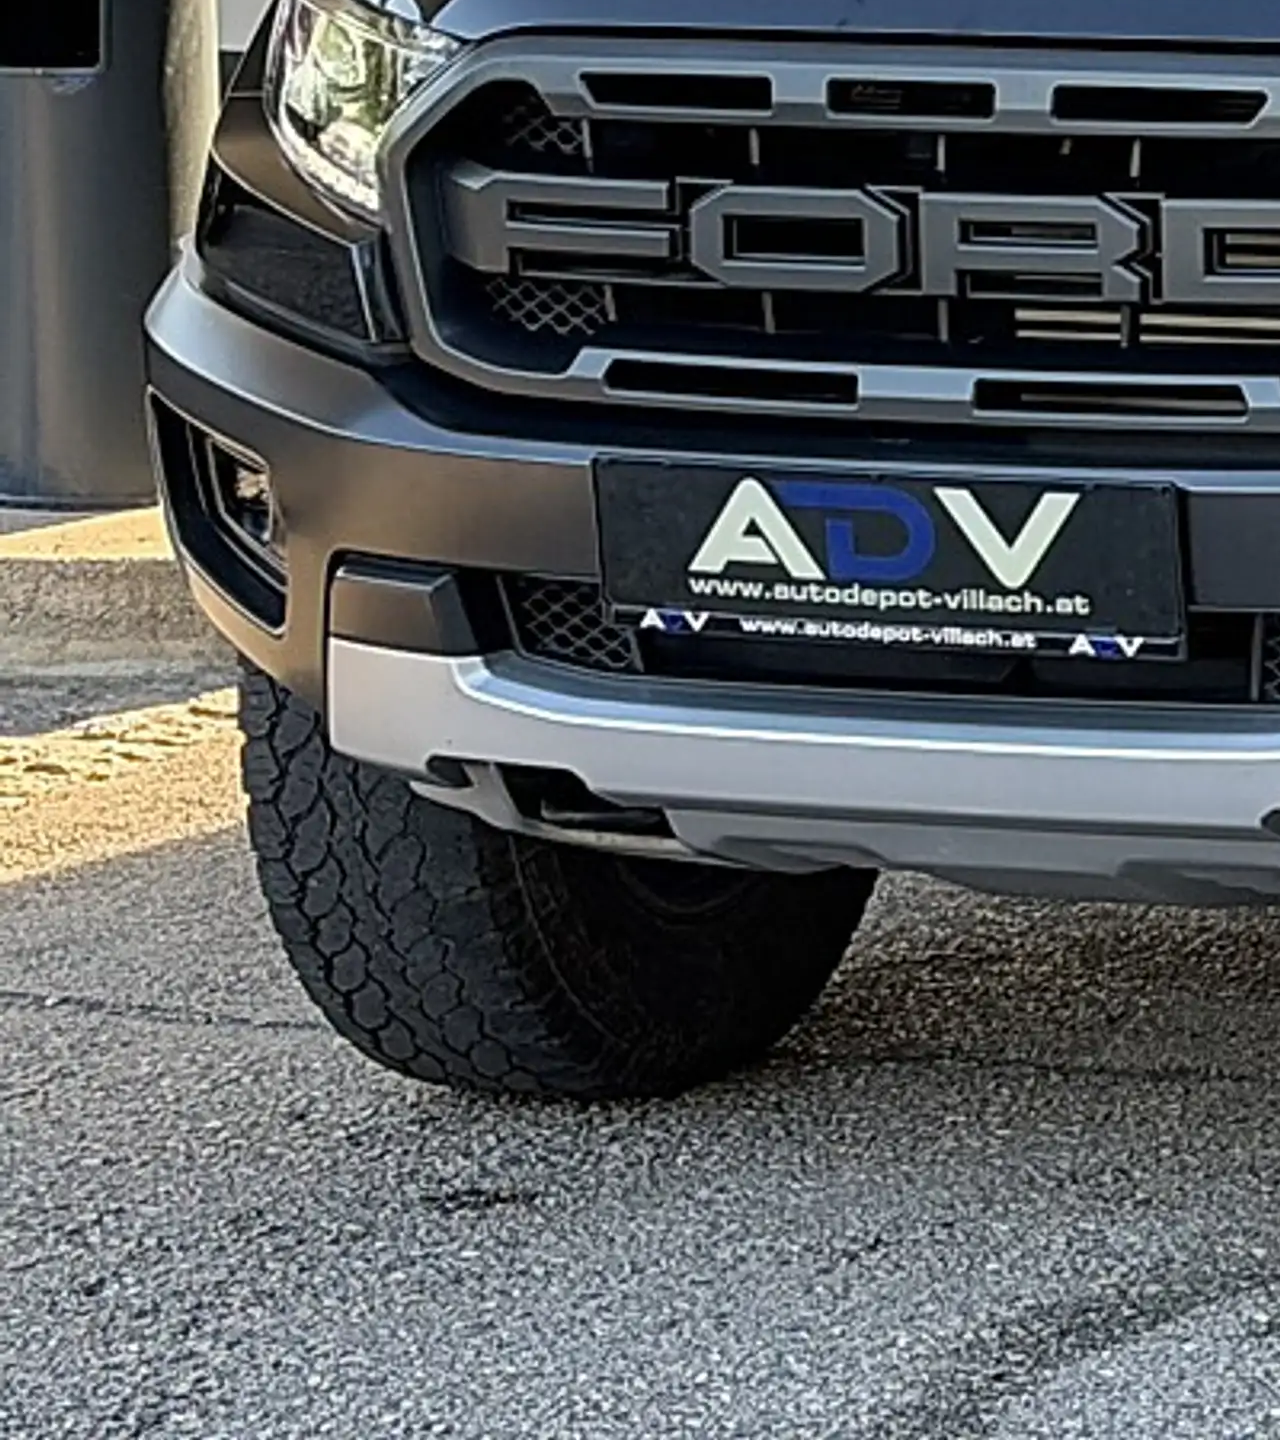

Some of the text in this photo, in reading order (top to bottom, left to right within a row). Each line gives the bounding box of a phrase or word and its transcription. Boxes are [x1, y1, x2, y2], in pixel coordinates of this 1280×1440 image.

[687, 477, 1081, 589] ADV
[688, 577, 1090, 615] www.autodepot-villach.at
[738, 616, 1037, 650] www.autodepot-villach.at
